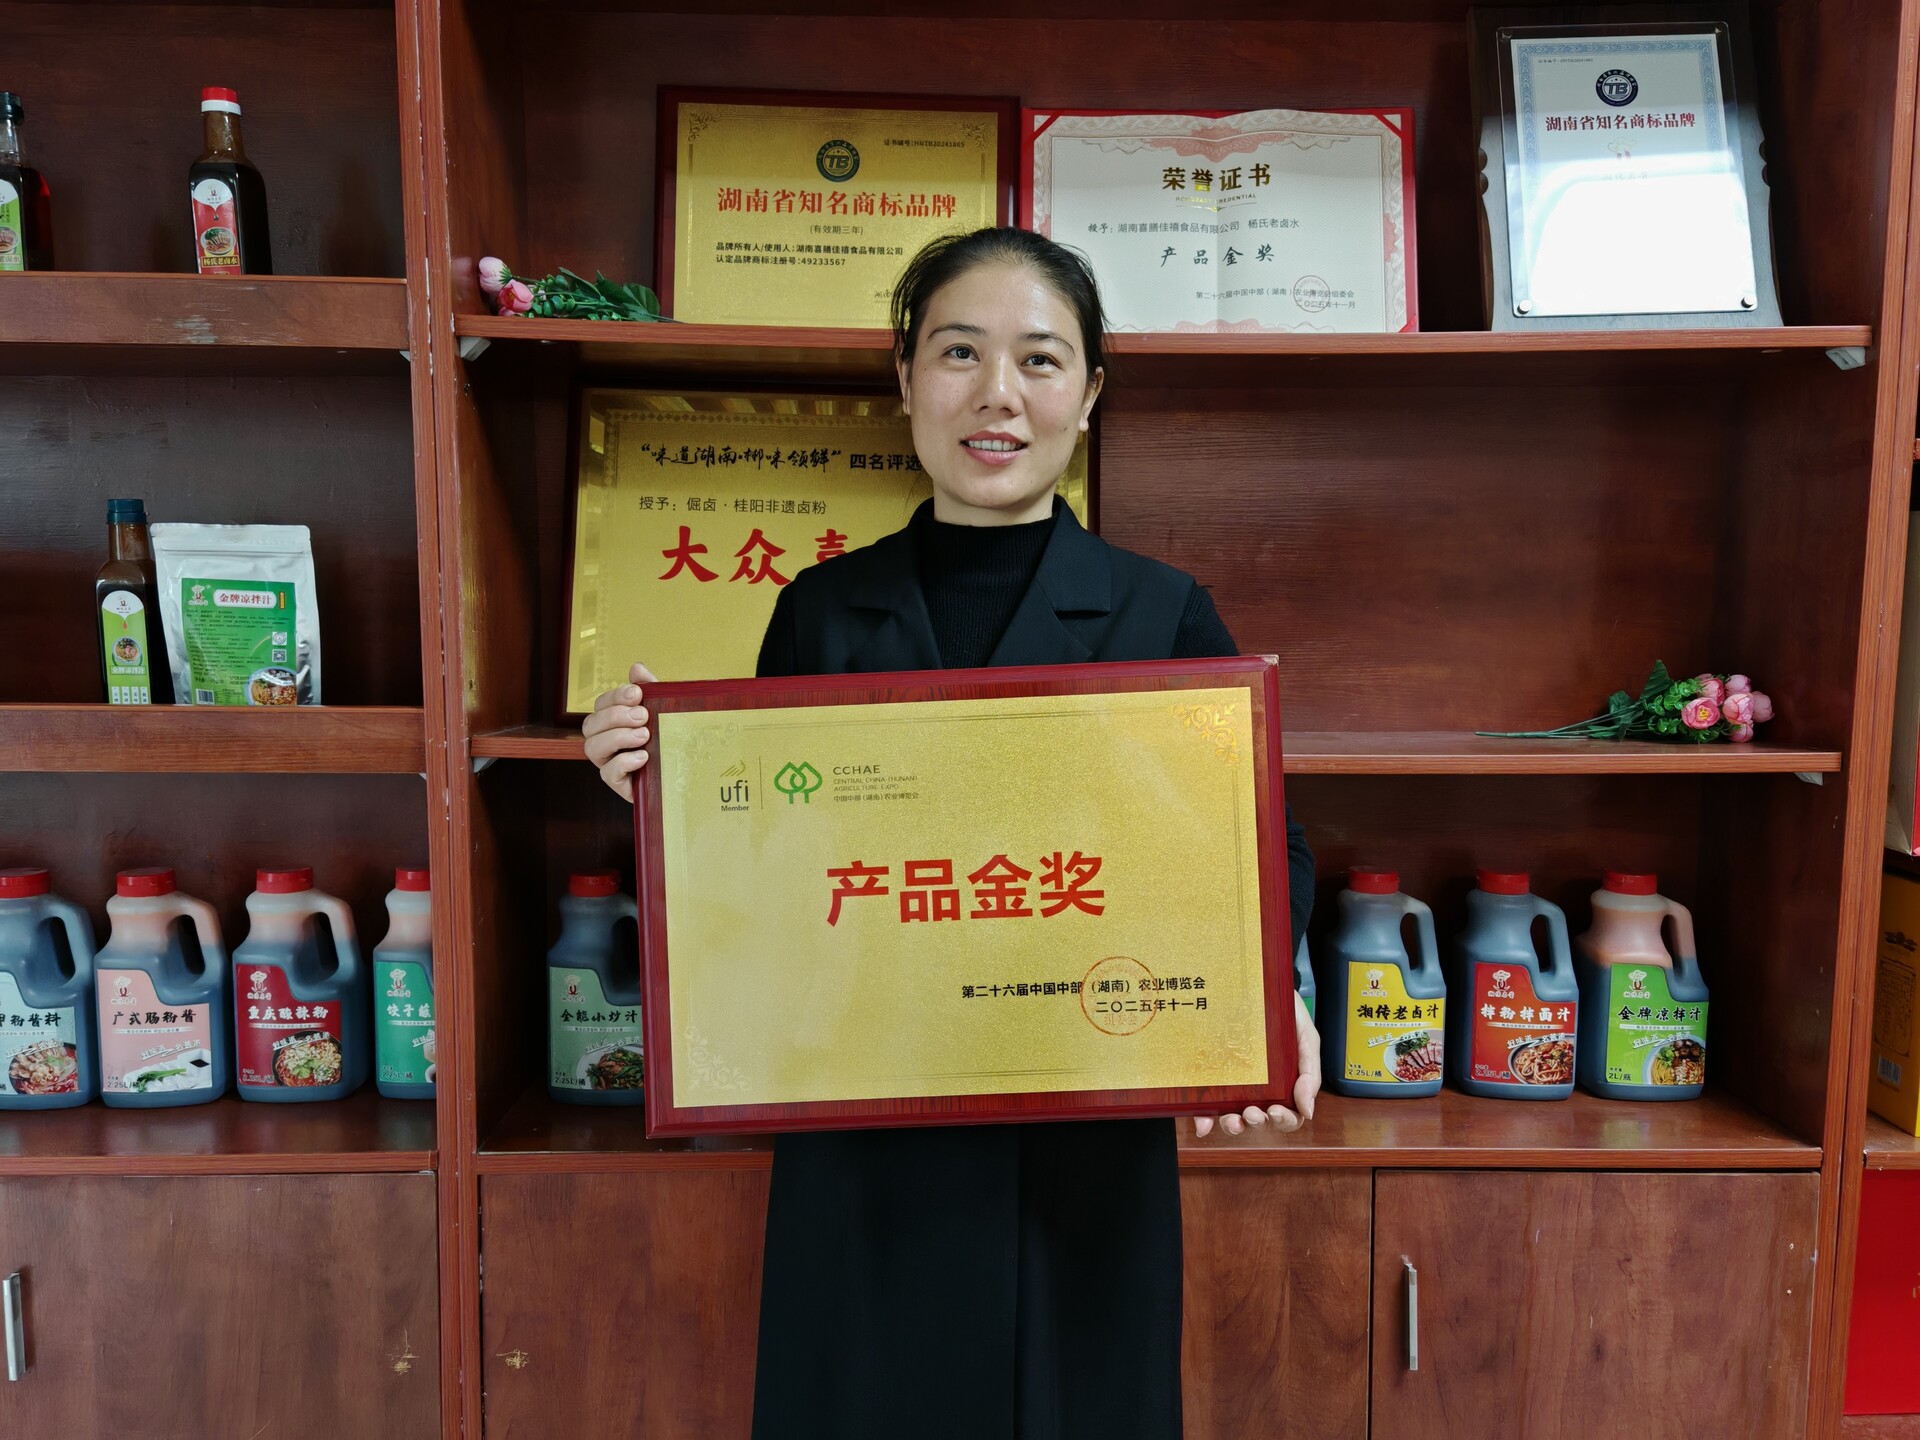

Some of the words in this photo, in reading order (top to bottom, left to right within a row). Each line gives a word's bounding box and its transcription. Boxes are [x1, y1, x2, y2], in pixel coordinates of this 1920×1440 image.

[1545, 112, 1696, 132] 湖南省知名商标品牌
[1162, 162, 1271, 192] 荣誉证书
[717, 187, 956, 219] 湖南省知名商标品牌
[1248, 217, 1300, 230] 杨氏老卤水
[1160, 243, 1275, 268] 产品金奖
[849, 453, 922, 472] 四名评选
[833, 764, 881, 776] CCHAE
[720, 779, 749, 803] ufi
[720, 804, 749, 812] Member
[826, 850, 1106, 928] 产品金奖
[112, 1009, 197, 1026] 广式肠粉酱
[248, 1005, 329, 1020] 重庆酸辣粉
[561, 1009, 638, 1024] 全能小炒汁
[1356, 1003, 1439, 1020] 湘传老卤汁
[1481, 1003, 1571, 1022] 拌粉拌面汁
[1617, 1005, 1702, 1023] 金牌凉拌汁
